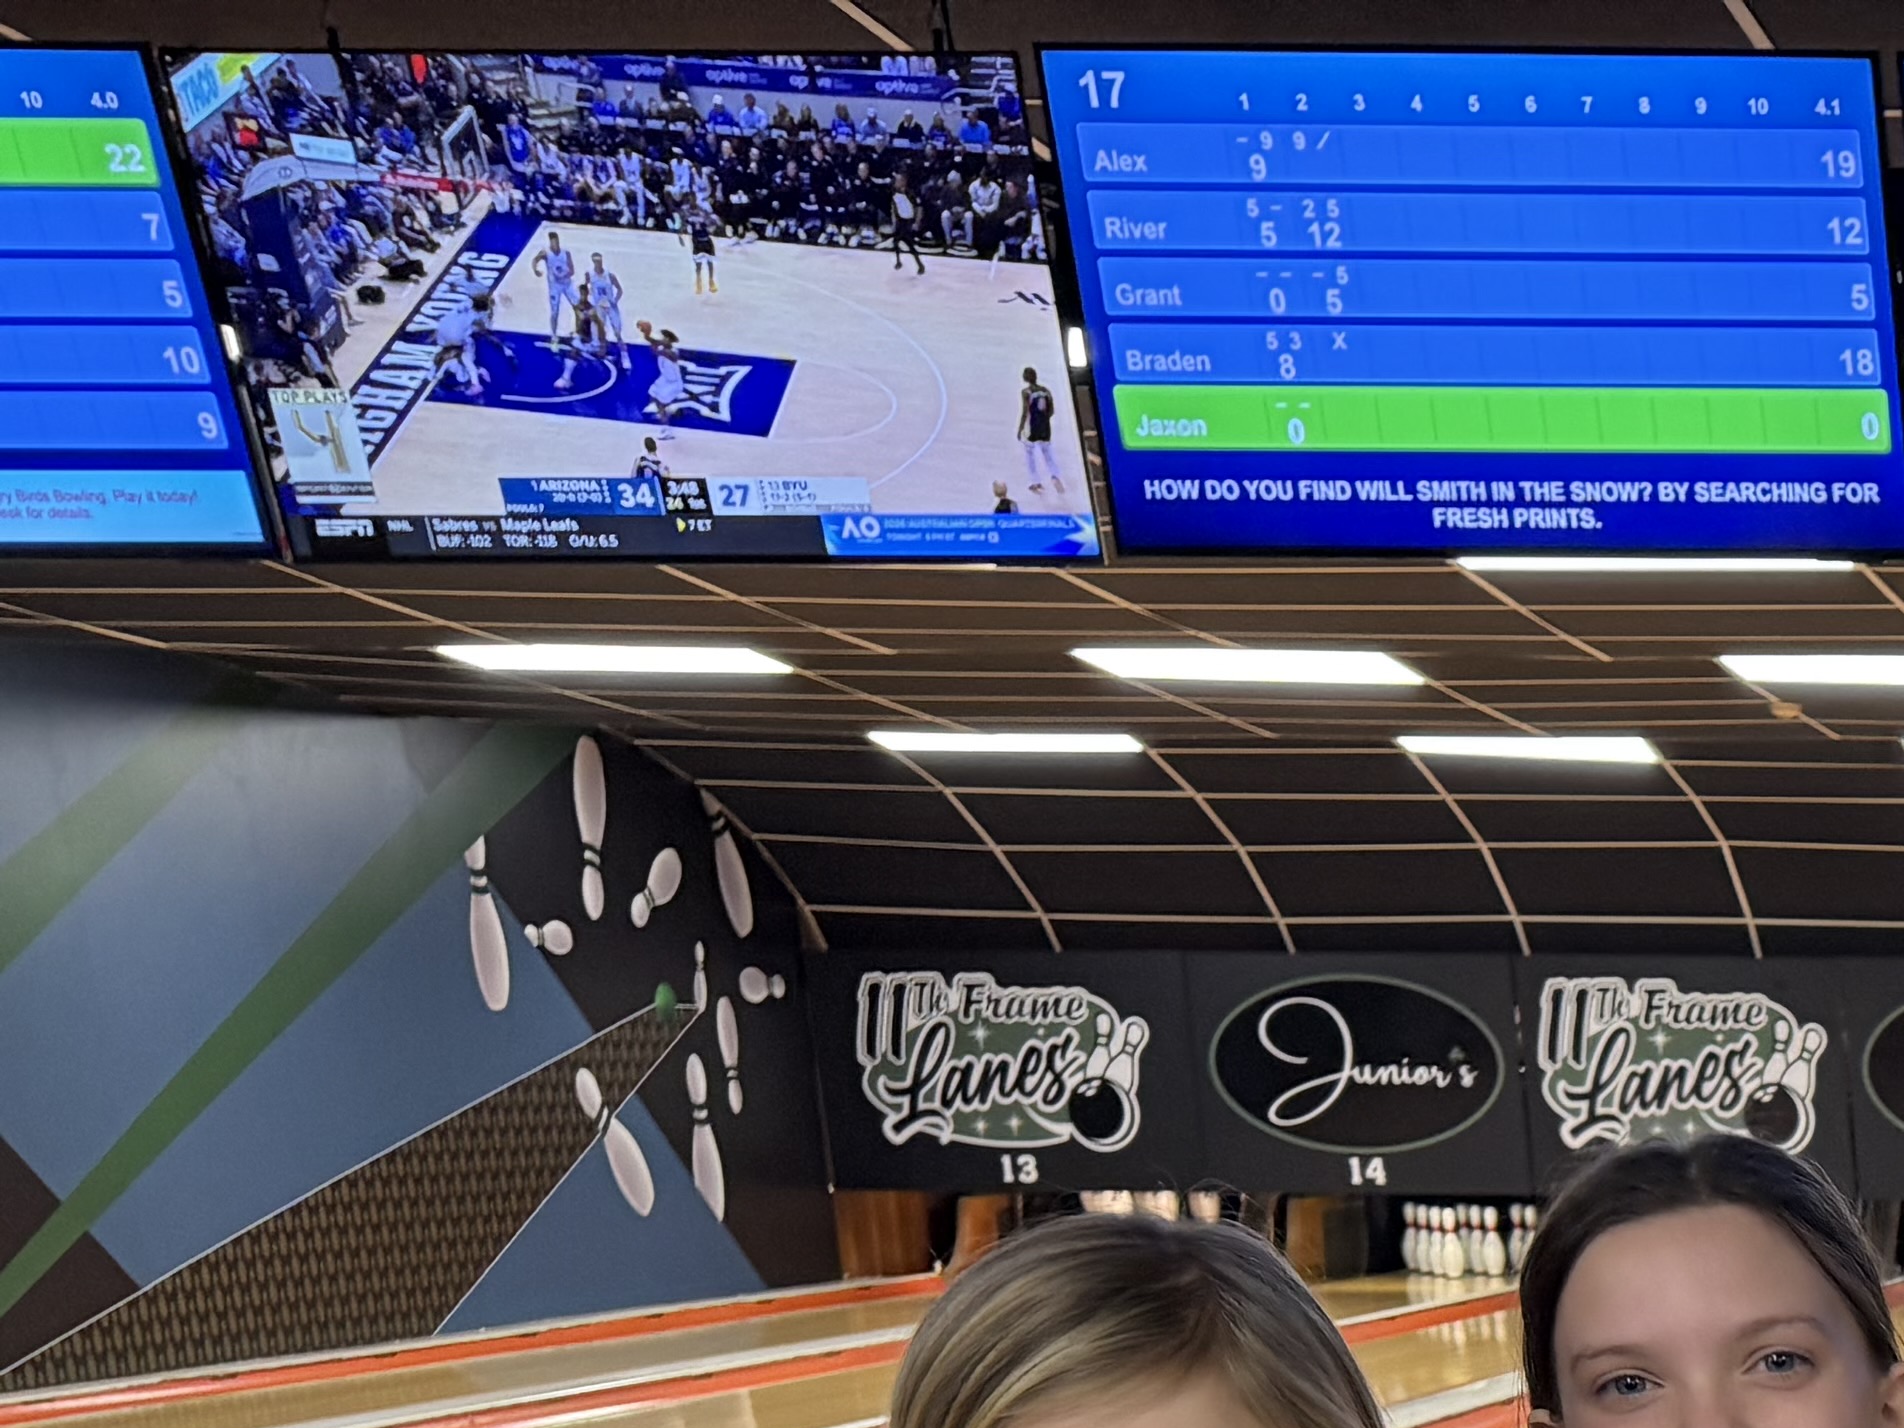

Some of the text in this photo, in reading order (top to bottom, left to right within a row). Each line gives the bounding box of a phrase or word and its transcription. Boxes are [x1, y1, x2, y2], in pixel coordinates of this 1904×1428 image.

[1078, 71, 1126, 109] 17
[104, 143, 144, 172] 22
[1095, 150, 1148, 175] Alex
[1819, 150, 1857, 179] 19
[142, 215, 161, 241] 7
[1104, 216, 1167, 242] River
[1826, 217, 1862, 246] 12
[163, 281, 184, 309] 5
[1114, 282, 1182, 309] Grant
[1850, 284, 1869, 312] 5
[163, 344, 200, 376] 10
[1125, 349, 1211, 375] Braden
[1839, 349, 1875, 377] 18
[198, 411, 218, 441] 9
[1135, 415, 1208, 439] Jaxon
[1860, 412, 1880, 441] 0
[616, 483, 655, 508] 34
[718, 484, 749, 508] 27
[1144, 479, 1881, 504] HOW DO YOU FIND WILL SMITH IN THE SNOW? BY SEARCHING FOR
[1432, 507, 1602, 529] FRESH PRINTS.
[954, 972, 1088, 1024] Frame
[1636, 978, 1768, 1029] Frame
[878, 1016, 1086, 1146] Lanes
[1556, 1021, 1764, 1149] Lanes
[1000, 1154, 1039, 1184] 13
[1349, 1156, 1387, 1186] 14
